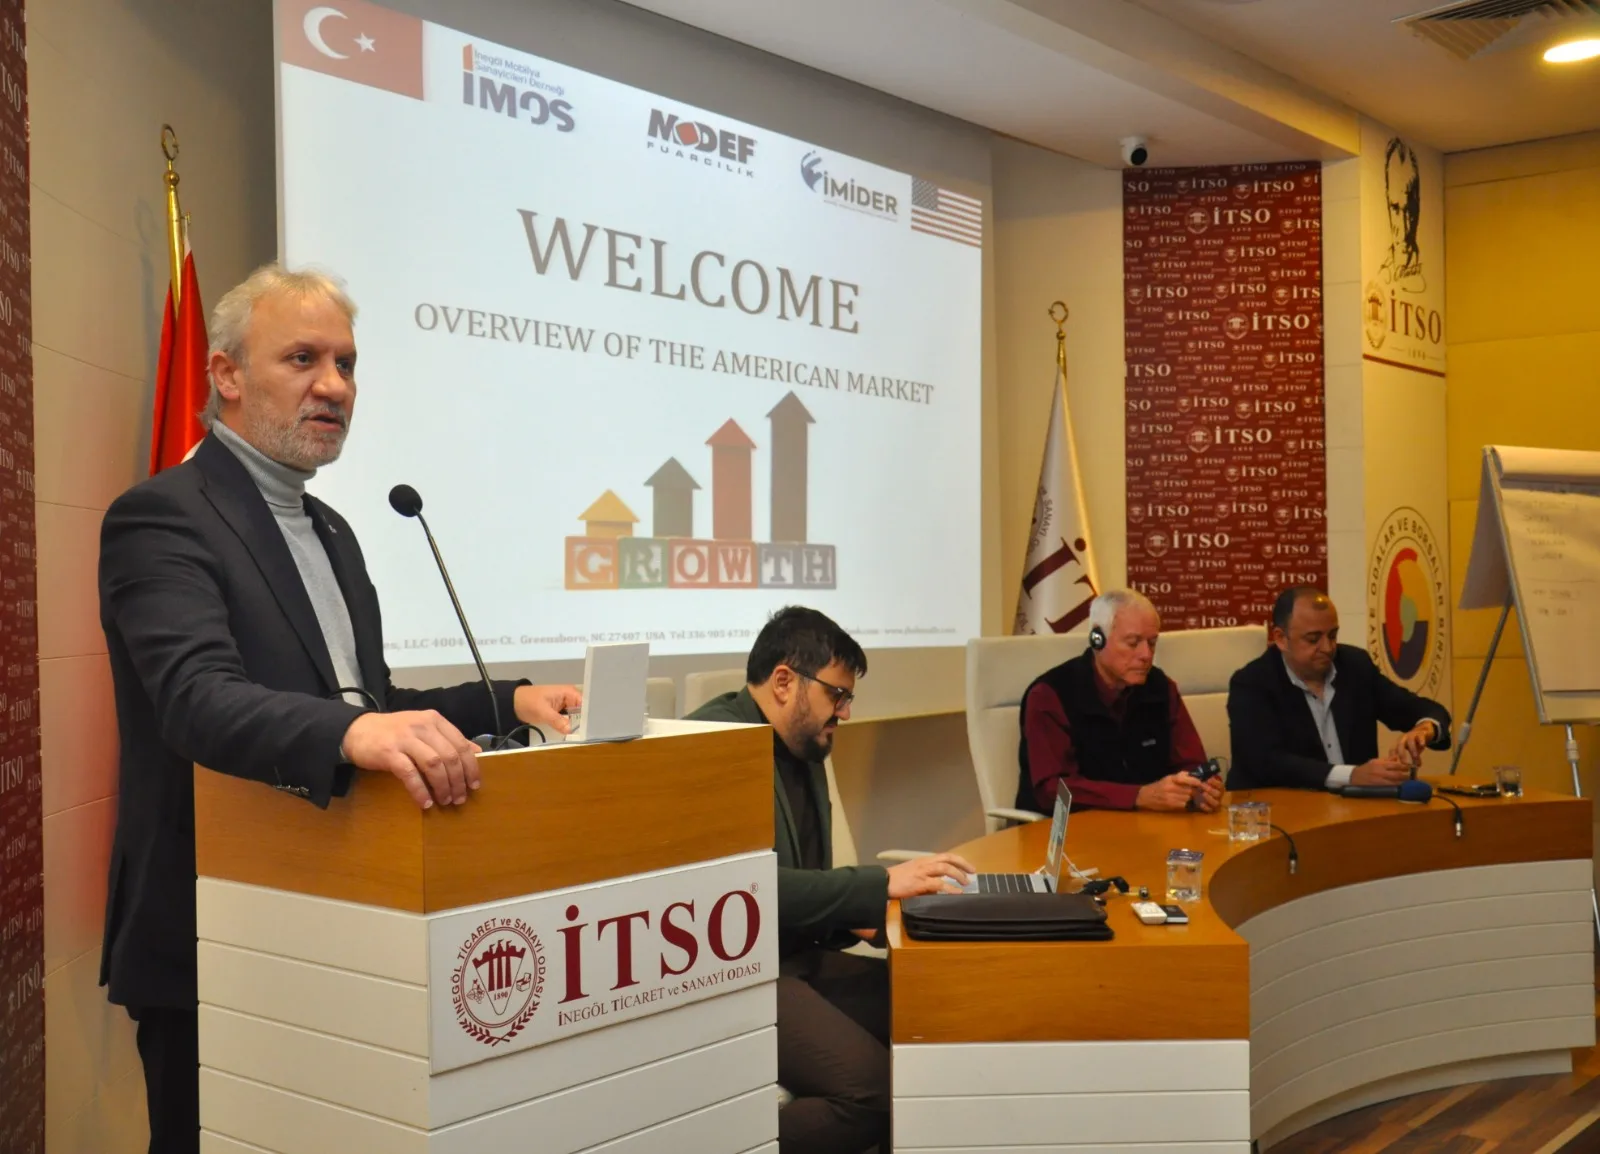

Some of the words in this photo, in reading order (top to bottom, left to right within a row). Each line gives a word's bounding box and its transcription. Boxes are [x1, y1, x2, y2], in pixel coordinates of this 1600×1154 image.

[504, 60, 540, 78] Mobilya
[647, 108, 754, 164] MODEF
[647, 141, 754, 178] FUARCILIK
[1192, 177, 1228, 189] İTSO
[1254, 180, 1294, 193] İTSO
[824, 170, 898, 215] İMİDER
[1213, 206, 1270, 225] İTSO
[1240, 245, 1276, 258] İTSO
[516, 208, 860, 334] WELCOME
[1146, 284, 1188, 299] İTSO
[1231, 282, 1266, 294] İTSO
[1178, 309, 1210, 320] İTSO
[1252, 312, 1310, 331] İTSO
[1390, 289, 1441, 345] İTSO
[414, 302, 595, 353] OVERVIEW
[603, 332, 641, 360] OF
[649, 338, 704, 371] THE
[711, 349, 840, 390] AMERICAN
[846, 370, 934, 405] MARKET
[1280, 351, 1316, 364] İTSO
[1194, 395, 1229, 408] İTSO
[1255, 399, 1296, 413] İTSO
[1215, 425, 1272, 444] İTSO
[1242, 465, 1278, 477] İTSO
[1148, 502, 1190, 517] İTSO
[1232, 501, 1268, 513] İTSO
[1173, 530, 1230, 548] İTSO
[1277, 543, 1309, 554] İTSO
[574, 543, 833, 584] GROWTH
[1282, 571, 1317, 584] İTSO
[1132, 580, 1172, 594] İTSO
[1202, 616, 1237, 627] İTSO
[404, 639, 428, 649] LLC
[432, 636, 464, 648] 4004
[520, 633, 590, 645] Greensboro,
[591, 632, 606, 641] NC
[645, 631, 665, 640] USA
[500, 918, 512, 926] ve
[457, 917, 497, 960] TİCARET
[514, 918, 545, 953] SANAYİ
[556, 889, 760, 1004] İTSO
[534, 956, 546, 998] ODASI
[450, 966, 466, 1020] İNEGÖL
[558, 1002, 608, 1026] İNEGÖL
[611, 987, 665, 1012] TİCARET
[667, 985, 679, 997] ve
[682, 969, 725, 993] SANAYİ
[727, 962, 761, 981] ODASI
